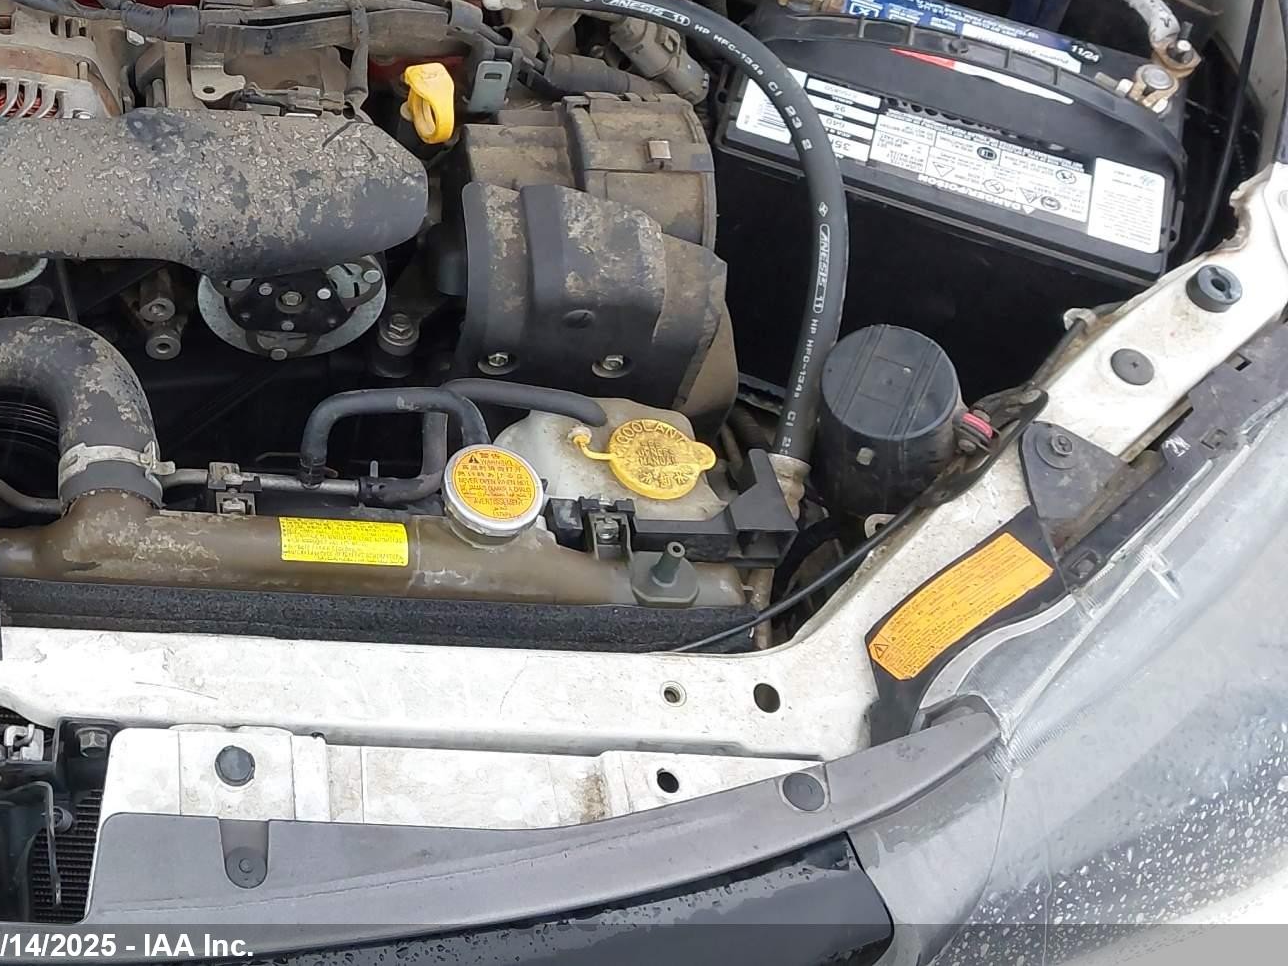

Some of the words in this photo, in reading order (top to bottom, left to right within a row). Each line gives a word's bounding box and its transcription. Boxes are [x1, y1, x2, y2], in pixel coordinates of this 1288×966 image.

[694, 24, 711, 35] HP
[1071, 44, 1100, 63] 11/24
[831, 138, 851, 151] 35
[810, 318, 819, 334] HP
[616, 420, 688, 444] COOLANT
